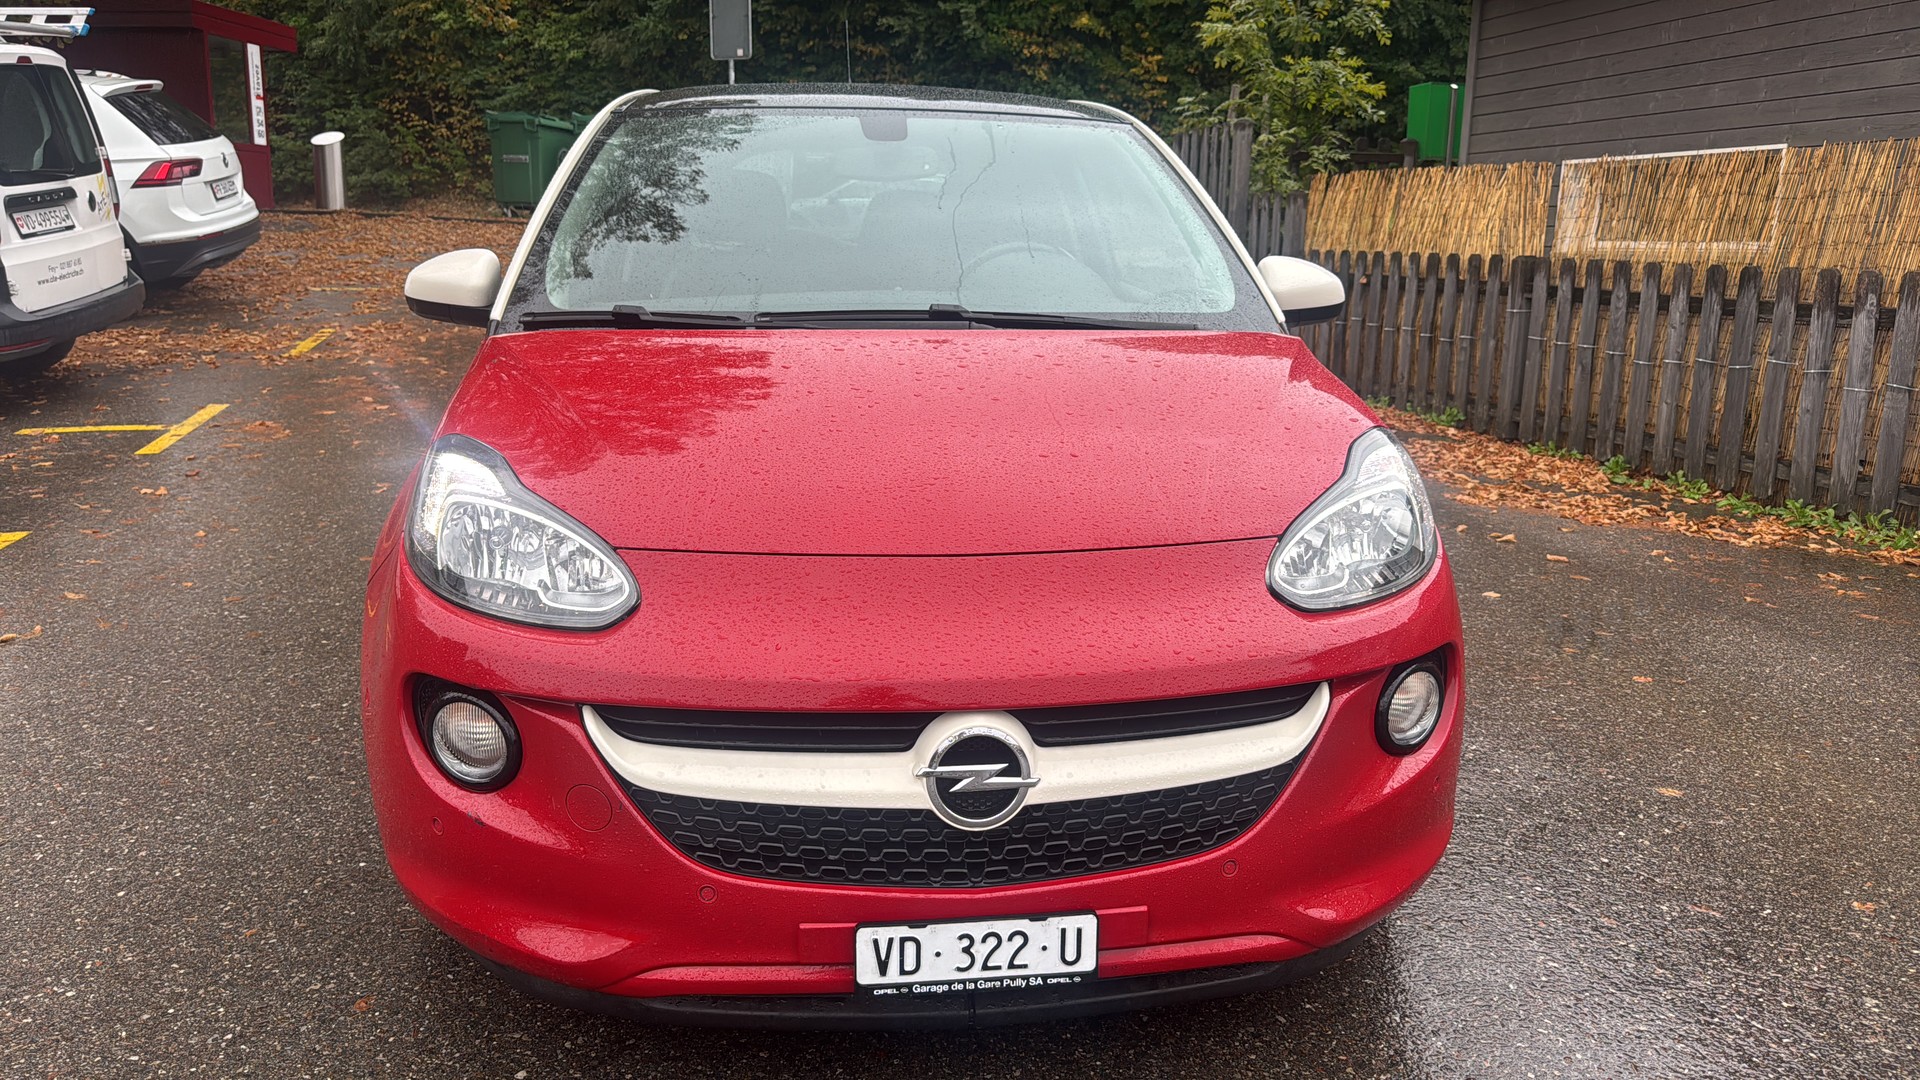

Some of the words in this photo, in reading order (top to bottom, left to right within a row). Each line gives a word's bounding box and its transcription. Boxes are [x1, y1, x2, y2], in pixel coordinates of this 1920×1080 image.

[872, 936, 921, 977] VD
[955, 929, 1029, 972] 322
[1060, 926, 1083, 966] U
[912, 984, 949, 994] Garage
[951, 982, 964, 990] de
[966, 981, 975, 989] la
[977, 980, 1001, 988] Gare
[1003, 977, 1028, 989] Pully
[1029, 976, 1044, 986] SA
